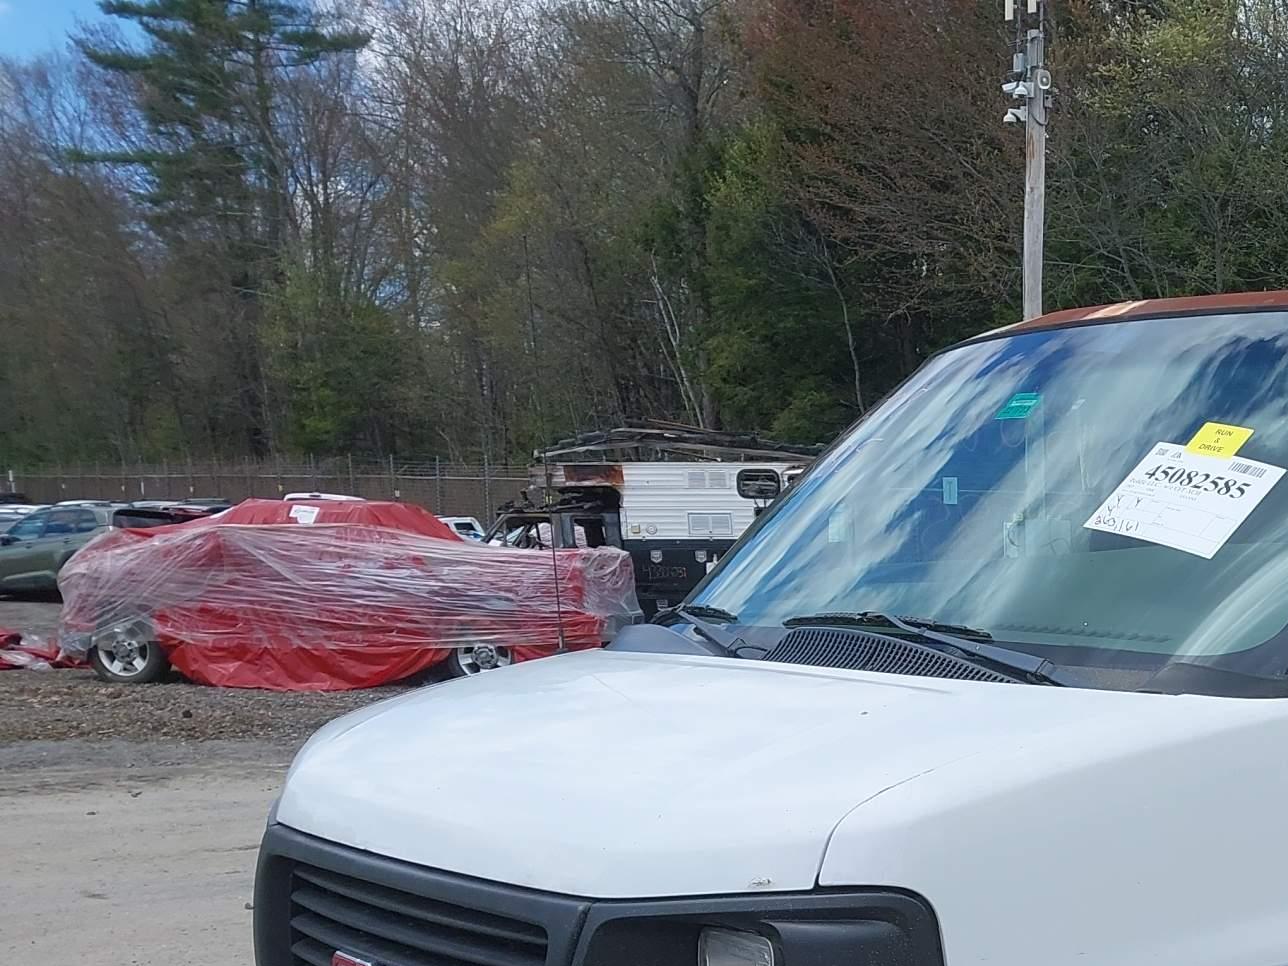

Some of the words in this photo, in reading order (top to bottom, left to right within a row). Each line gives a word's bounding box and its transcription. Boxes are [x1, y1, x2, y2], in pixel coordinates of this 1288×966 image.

[1215, 428, 1234, 437] RUN
[1198, 443, 1225, 453] DRIVE
[1144, 464, 1253, 499] 45082585
